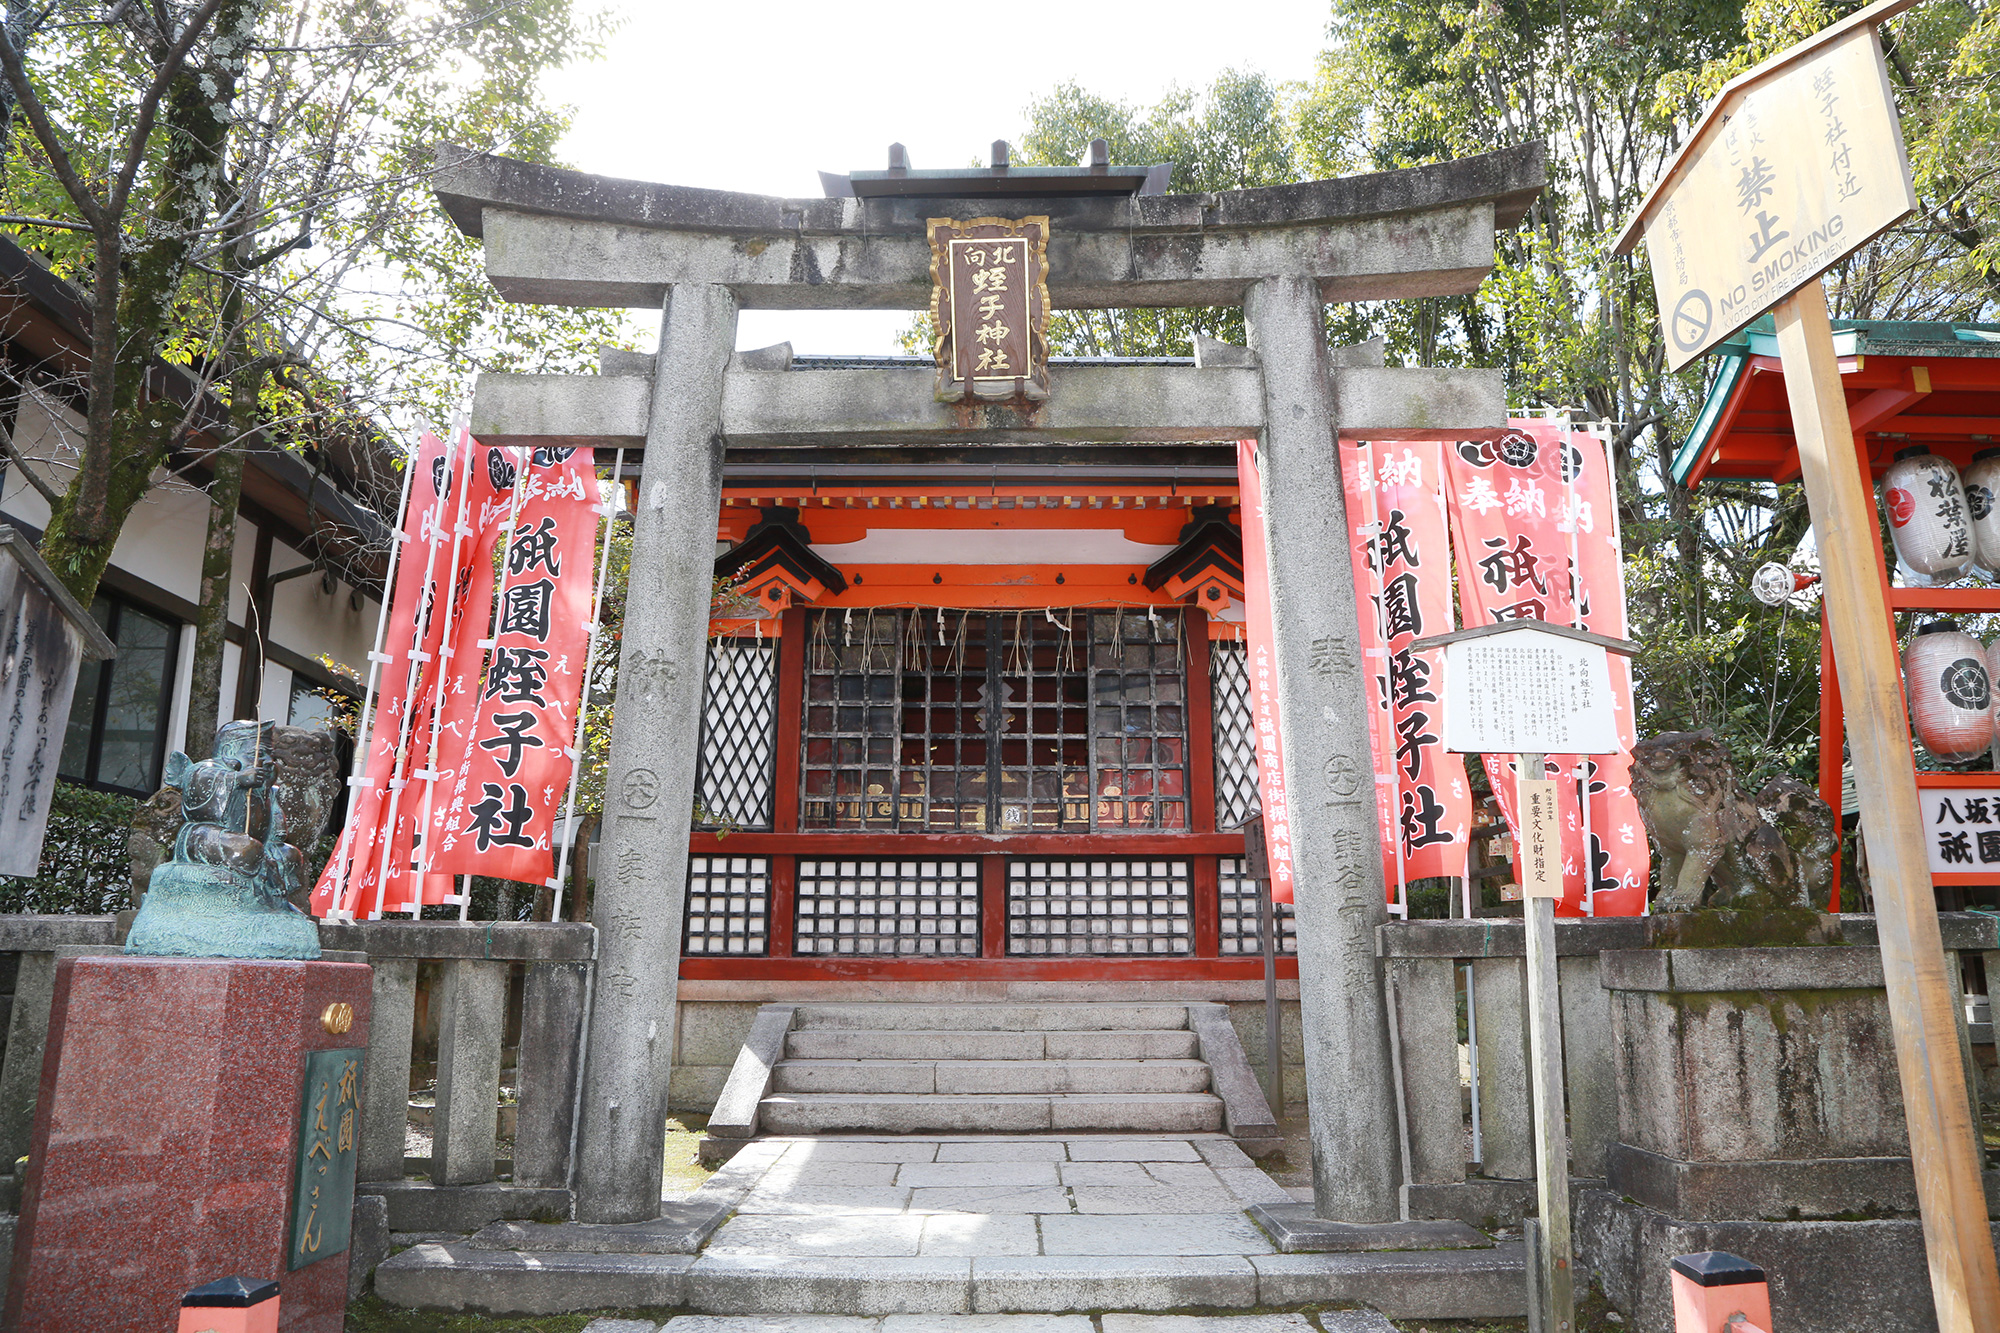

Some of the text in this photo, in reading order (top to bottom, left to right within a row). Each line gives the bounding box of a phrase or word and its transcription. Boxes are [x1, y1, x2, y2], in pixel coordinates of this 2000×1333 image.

[1813, 66, 1864, 203] 蛭子社付近
[1735, 156, 1790, 264] 禁止
[1719, 214, 1844, 316] NO SMOKING
[1724, 236, 1847, 330] KYOTO CITY FIRE DEPARTMENT
[971, 266, 1010, 371] 蛭子神社
[1459, 475, 1546, 519] 奉納
[1927, 468, 1969, 560] 松葉屋
[461, 516, 563, 852] 祇園蛭子社
[1309, 634, 1355, 688] 奉
[1579, 657, 1592, 709] 北向蛭子社
[1530, 793, 1547, 883] 重要文化財指定
